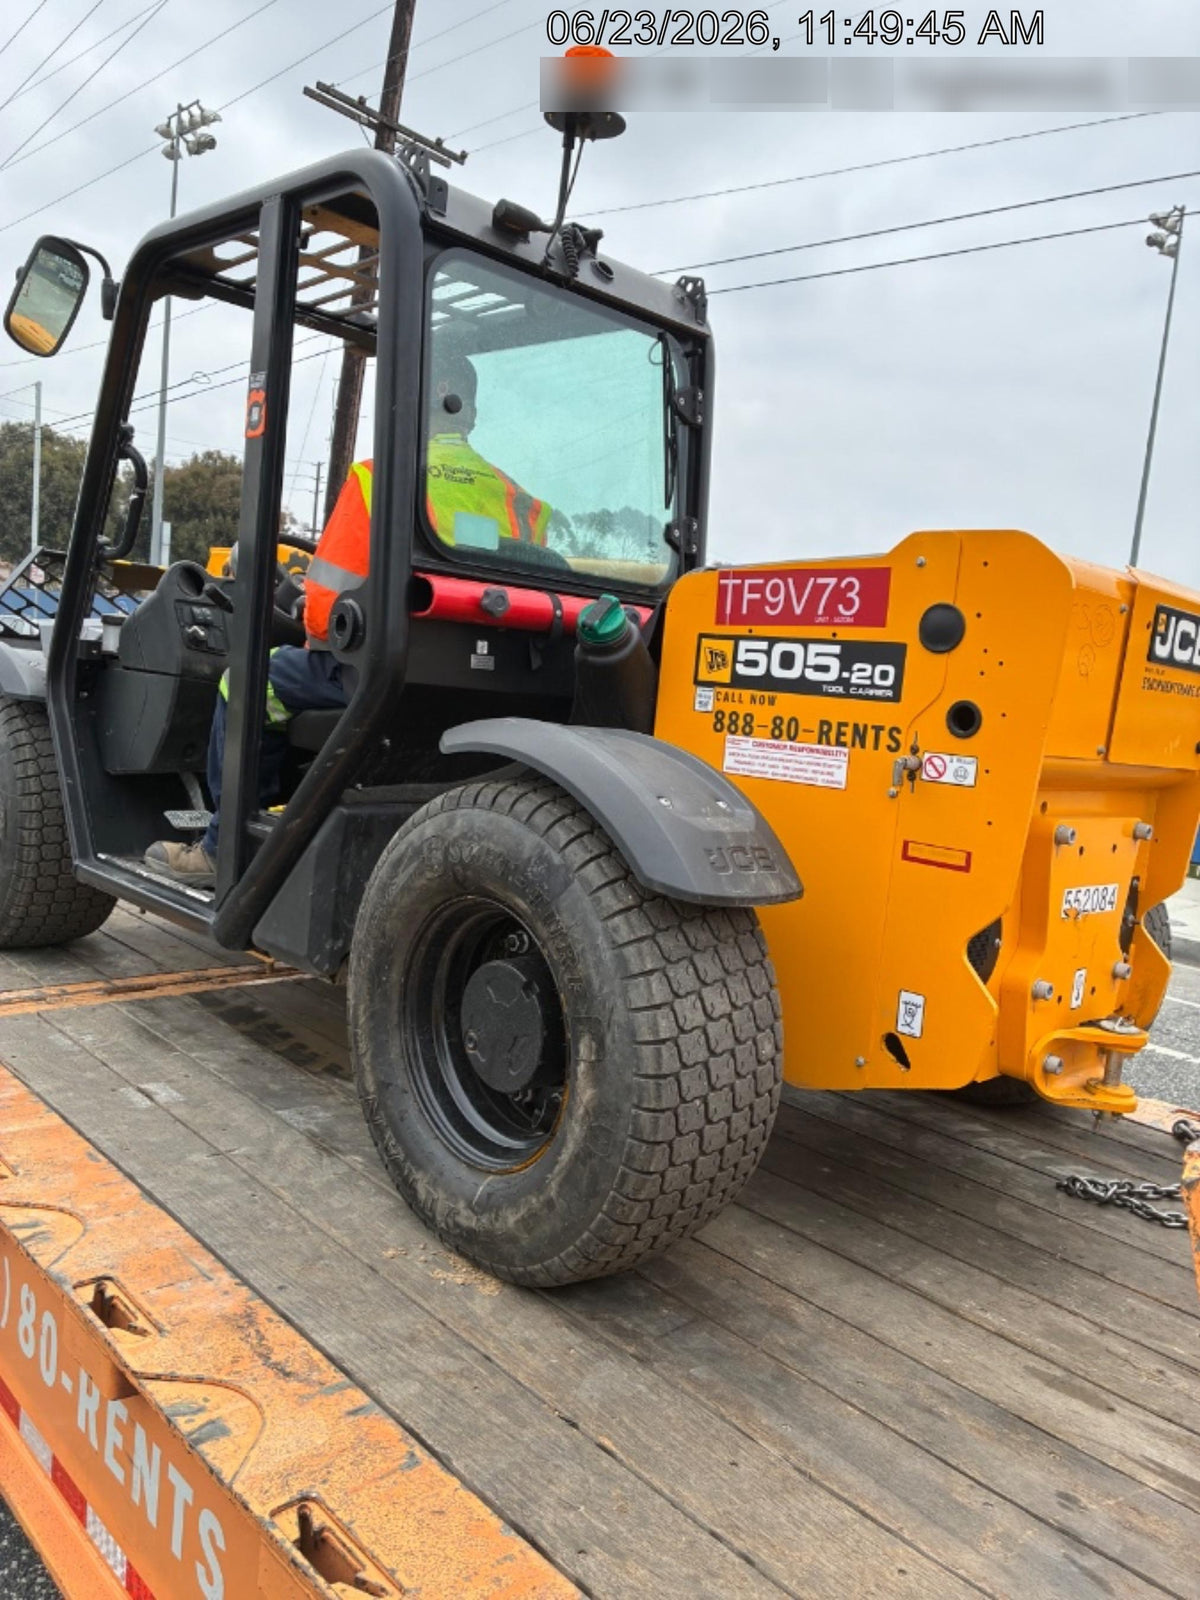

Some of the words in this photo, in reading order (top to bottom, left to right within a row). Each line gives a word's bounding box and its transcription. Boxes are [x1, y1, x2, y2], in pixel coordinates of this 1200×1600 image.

[719, 577, 861, 616] TF9V73
[715, 691, 743, 704] CALL
[750, 694, 777, 706] NOW
[822, 684, 846, 694] TOOL
[849, 686, 893, 697] CARRIER
[712, 710, 901, 753] 888-80-RENTS
[704, 847, 778, 875] JCB
[1064, 886, 1117, 914] 552084
[17, 1283, 227, 1600] 80-RENTS
